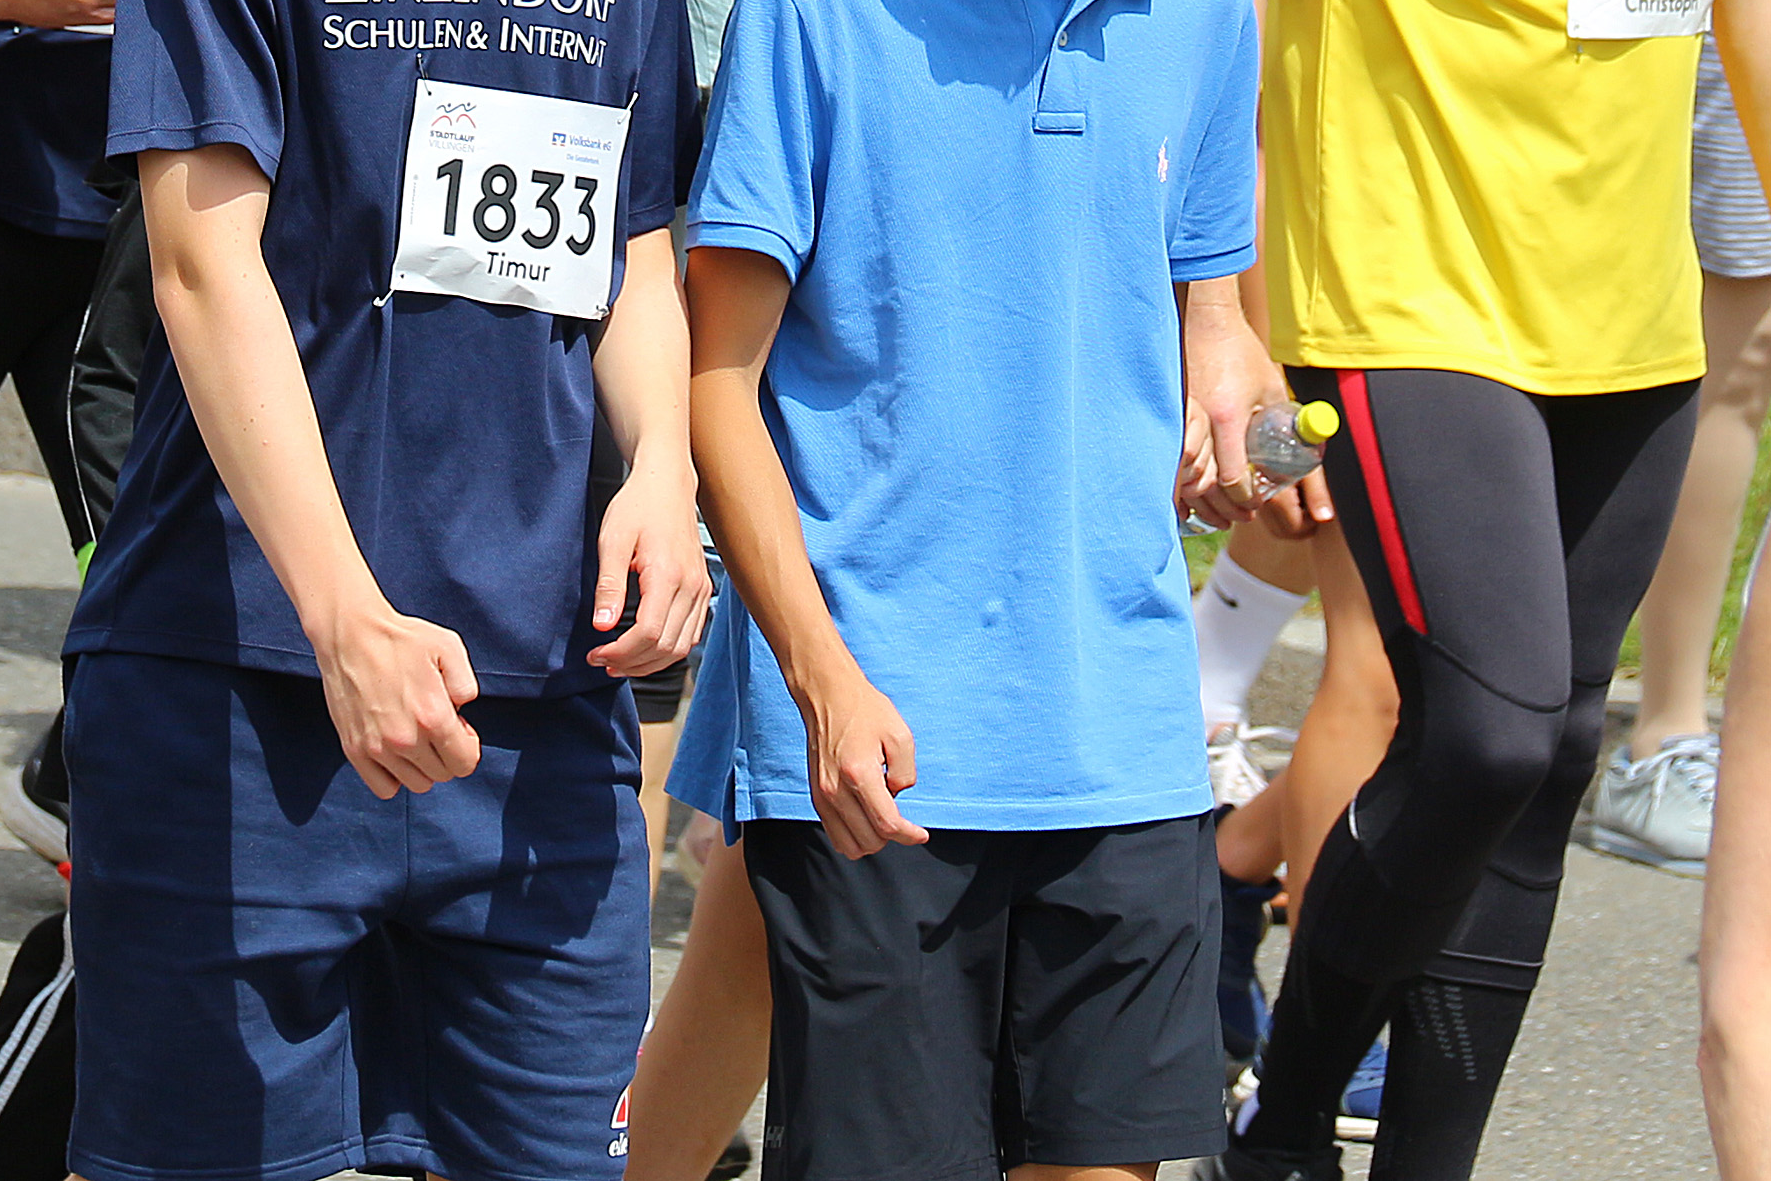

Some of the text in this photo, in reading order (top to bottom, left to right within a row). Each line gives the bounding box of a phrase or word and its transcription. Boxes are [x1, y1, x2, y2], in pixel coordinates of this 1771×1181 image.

[323, 15, 463, 49] SCHULEN
[465, 21, 489, 50] &
[429, 129, 476, 143] STADTLAUF
[436, 158, 599, 257] 1833
[486, 251, 552, 283] Timur
